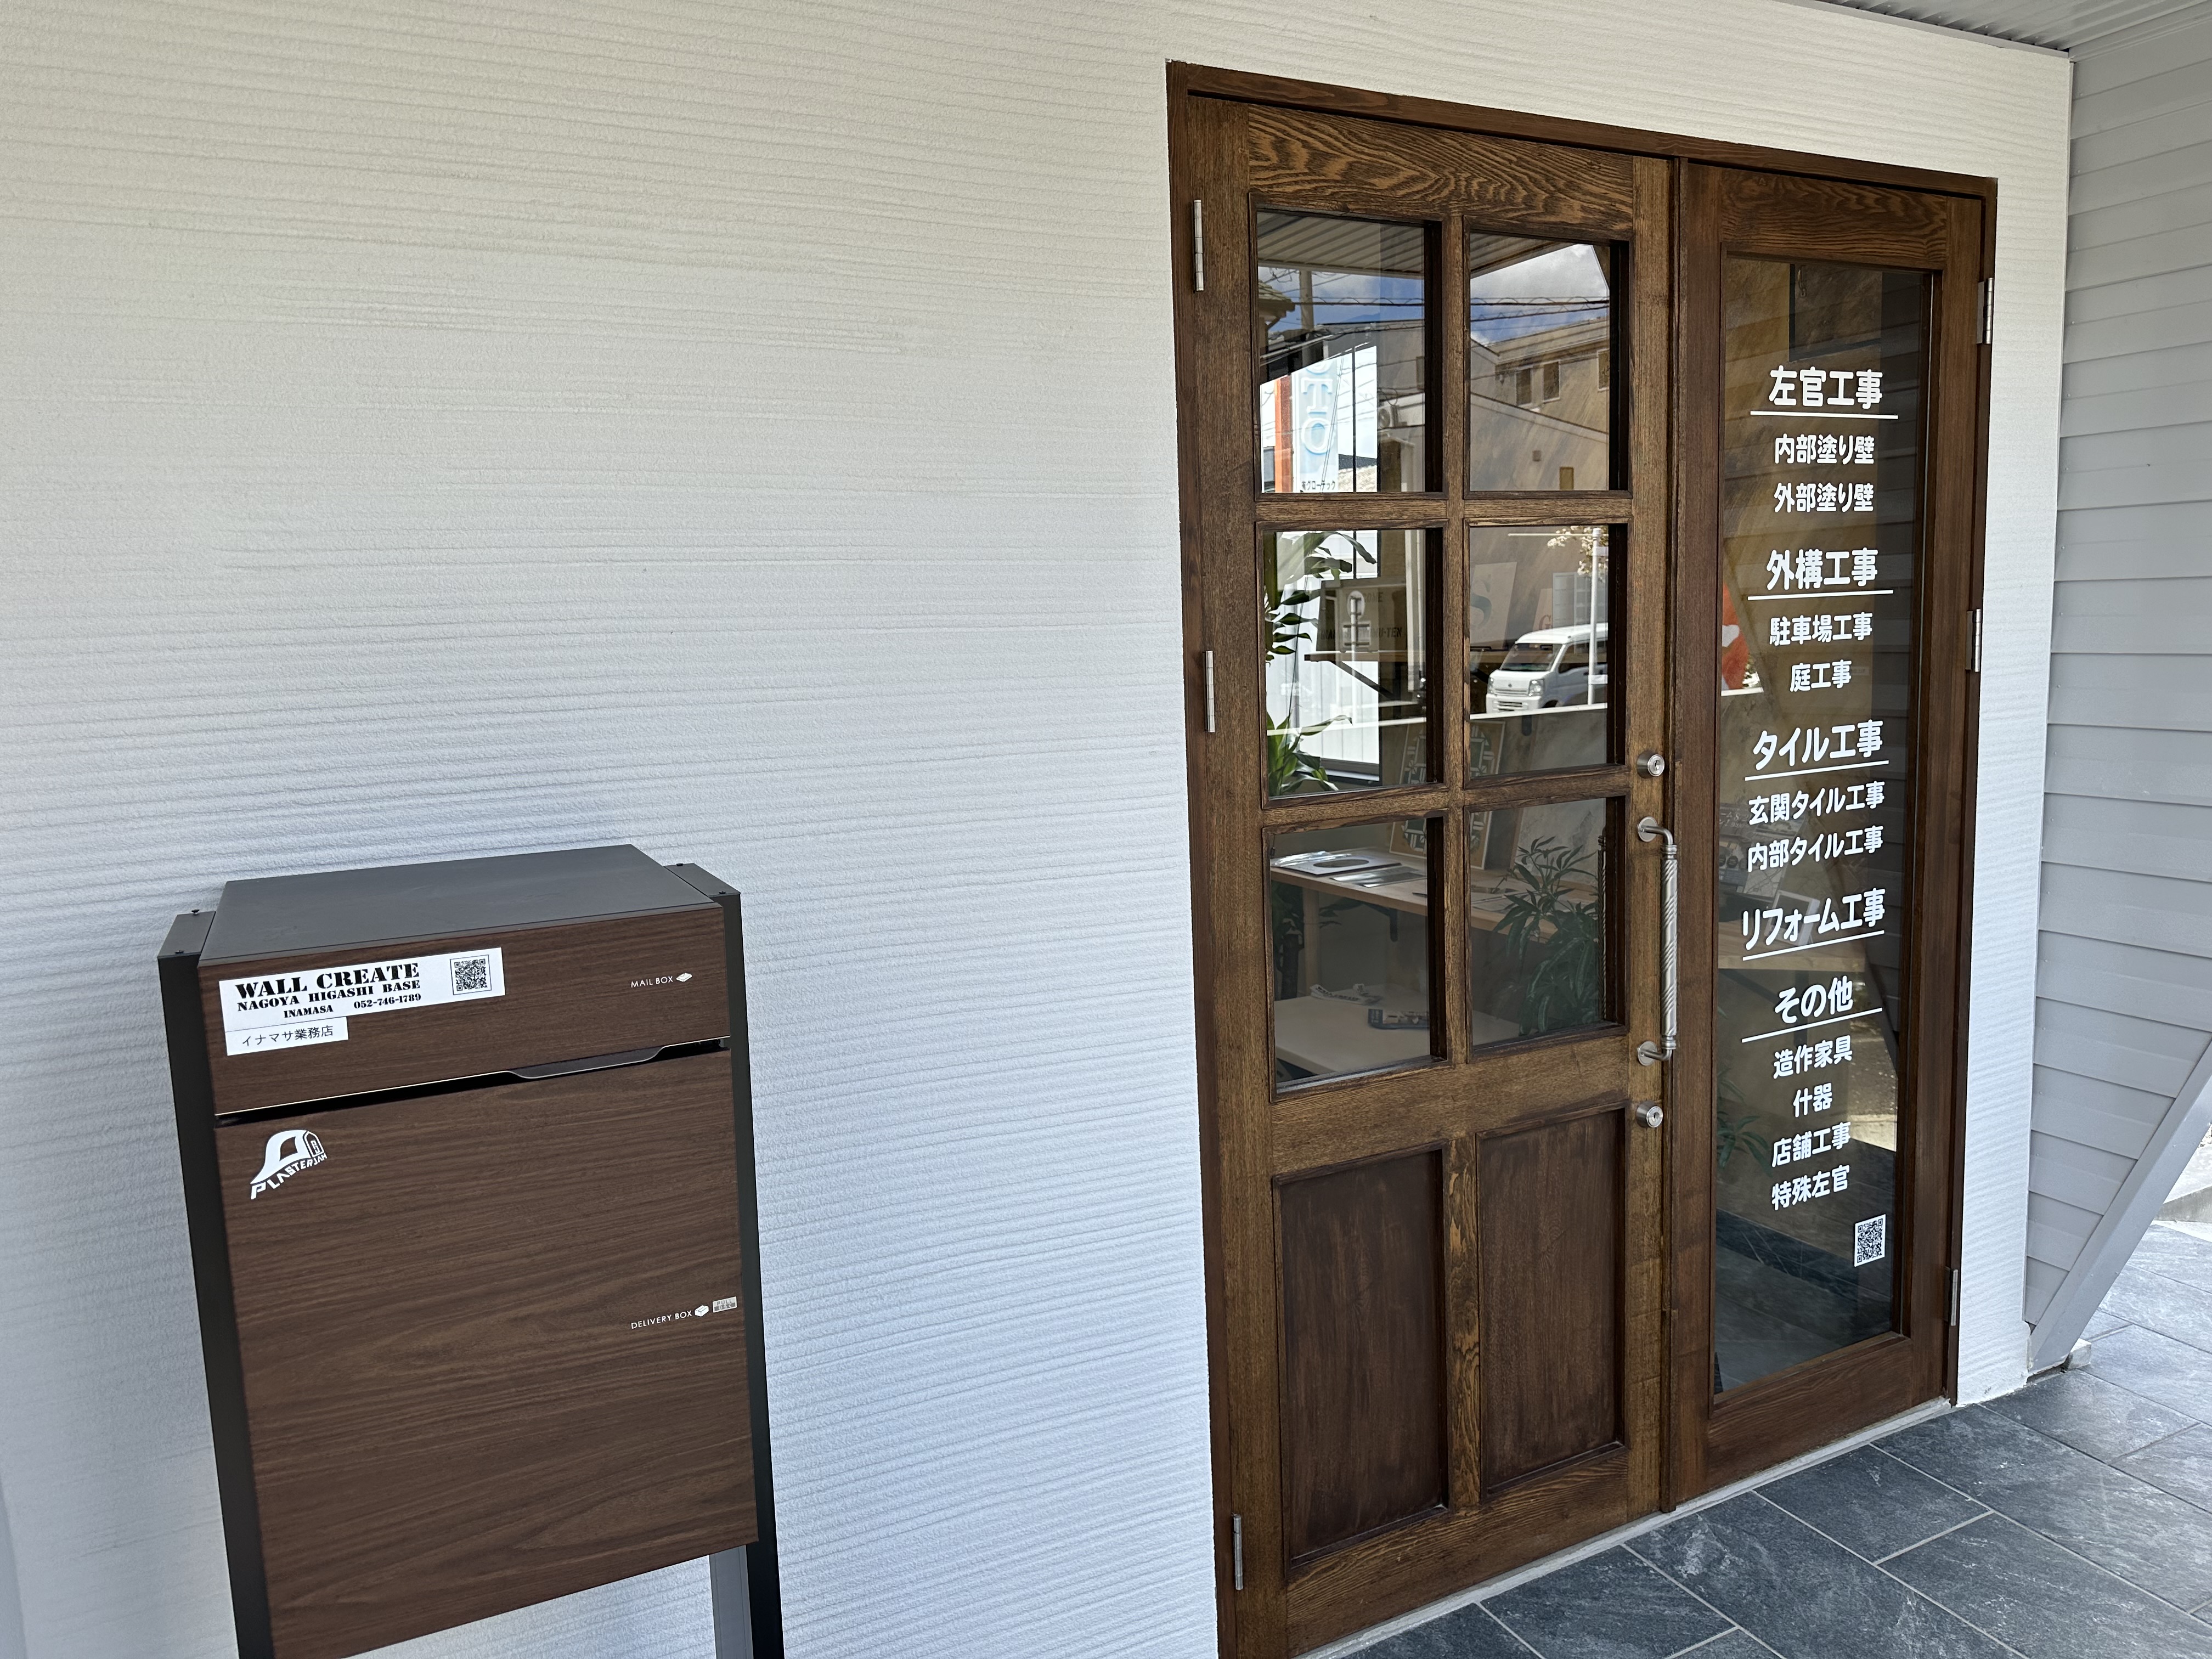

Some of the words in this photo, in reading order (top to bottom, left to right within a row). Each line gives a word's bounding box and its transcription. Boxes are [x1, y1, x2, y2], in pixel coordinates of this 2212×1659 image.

[1769, 365, 1882, 409] 左官工事
[1775, 434, 1874, 464] 内部塗り壁
[1774, 483, 1874, 512] 外部塗り壁
[1767, 548, 1878, 590] 外構工事
[1770, 612, 1872, 646] 駐車場工事
[1790, 660, 1851, 691] 庭工事
[1753, 720, 1883, 770] タイル工事
[1749, 781, 1884, 825] 玄関タイル工事
[1748, 826, 1883, 872] 内部タイル工事
[1743, 888, 1885, 950] リフォーム工事
[235, 977, 307, 998] WALL
[317, 963, 419, 989] CREATE
[238, 996, 300, 1011] NAGOYA
[309, 986, 373, 1002] HIGASHI
[382, 980, 420, 992] BASE
[631, 979, 653, 988] MAIL
[656, 976, 673, 984] BOX
[1775, 976, 1853, 1023] その他
[284, 1005, 333, 1018] INAMASA
[354, 994, 421, 1008] 052-746-1789
[243, 1025, 332, 1046] イナマサ業務店
[1774, 1035, 1852, 1079] 造作家具
[1793, 1083, 1832, 1117] 什器
[1772, 1122, 1850, 1167] 店舗工事
[251, 1153, 328, 1200] PLASTERJAM
[1772, 1165, 1849, 1210] 特殊左官
[631, 1314, 672, 1329] DELIVERY
[675, 1310, 692, 1319] BOX
